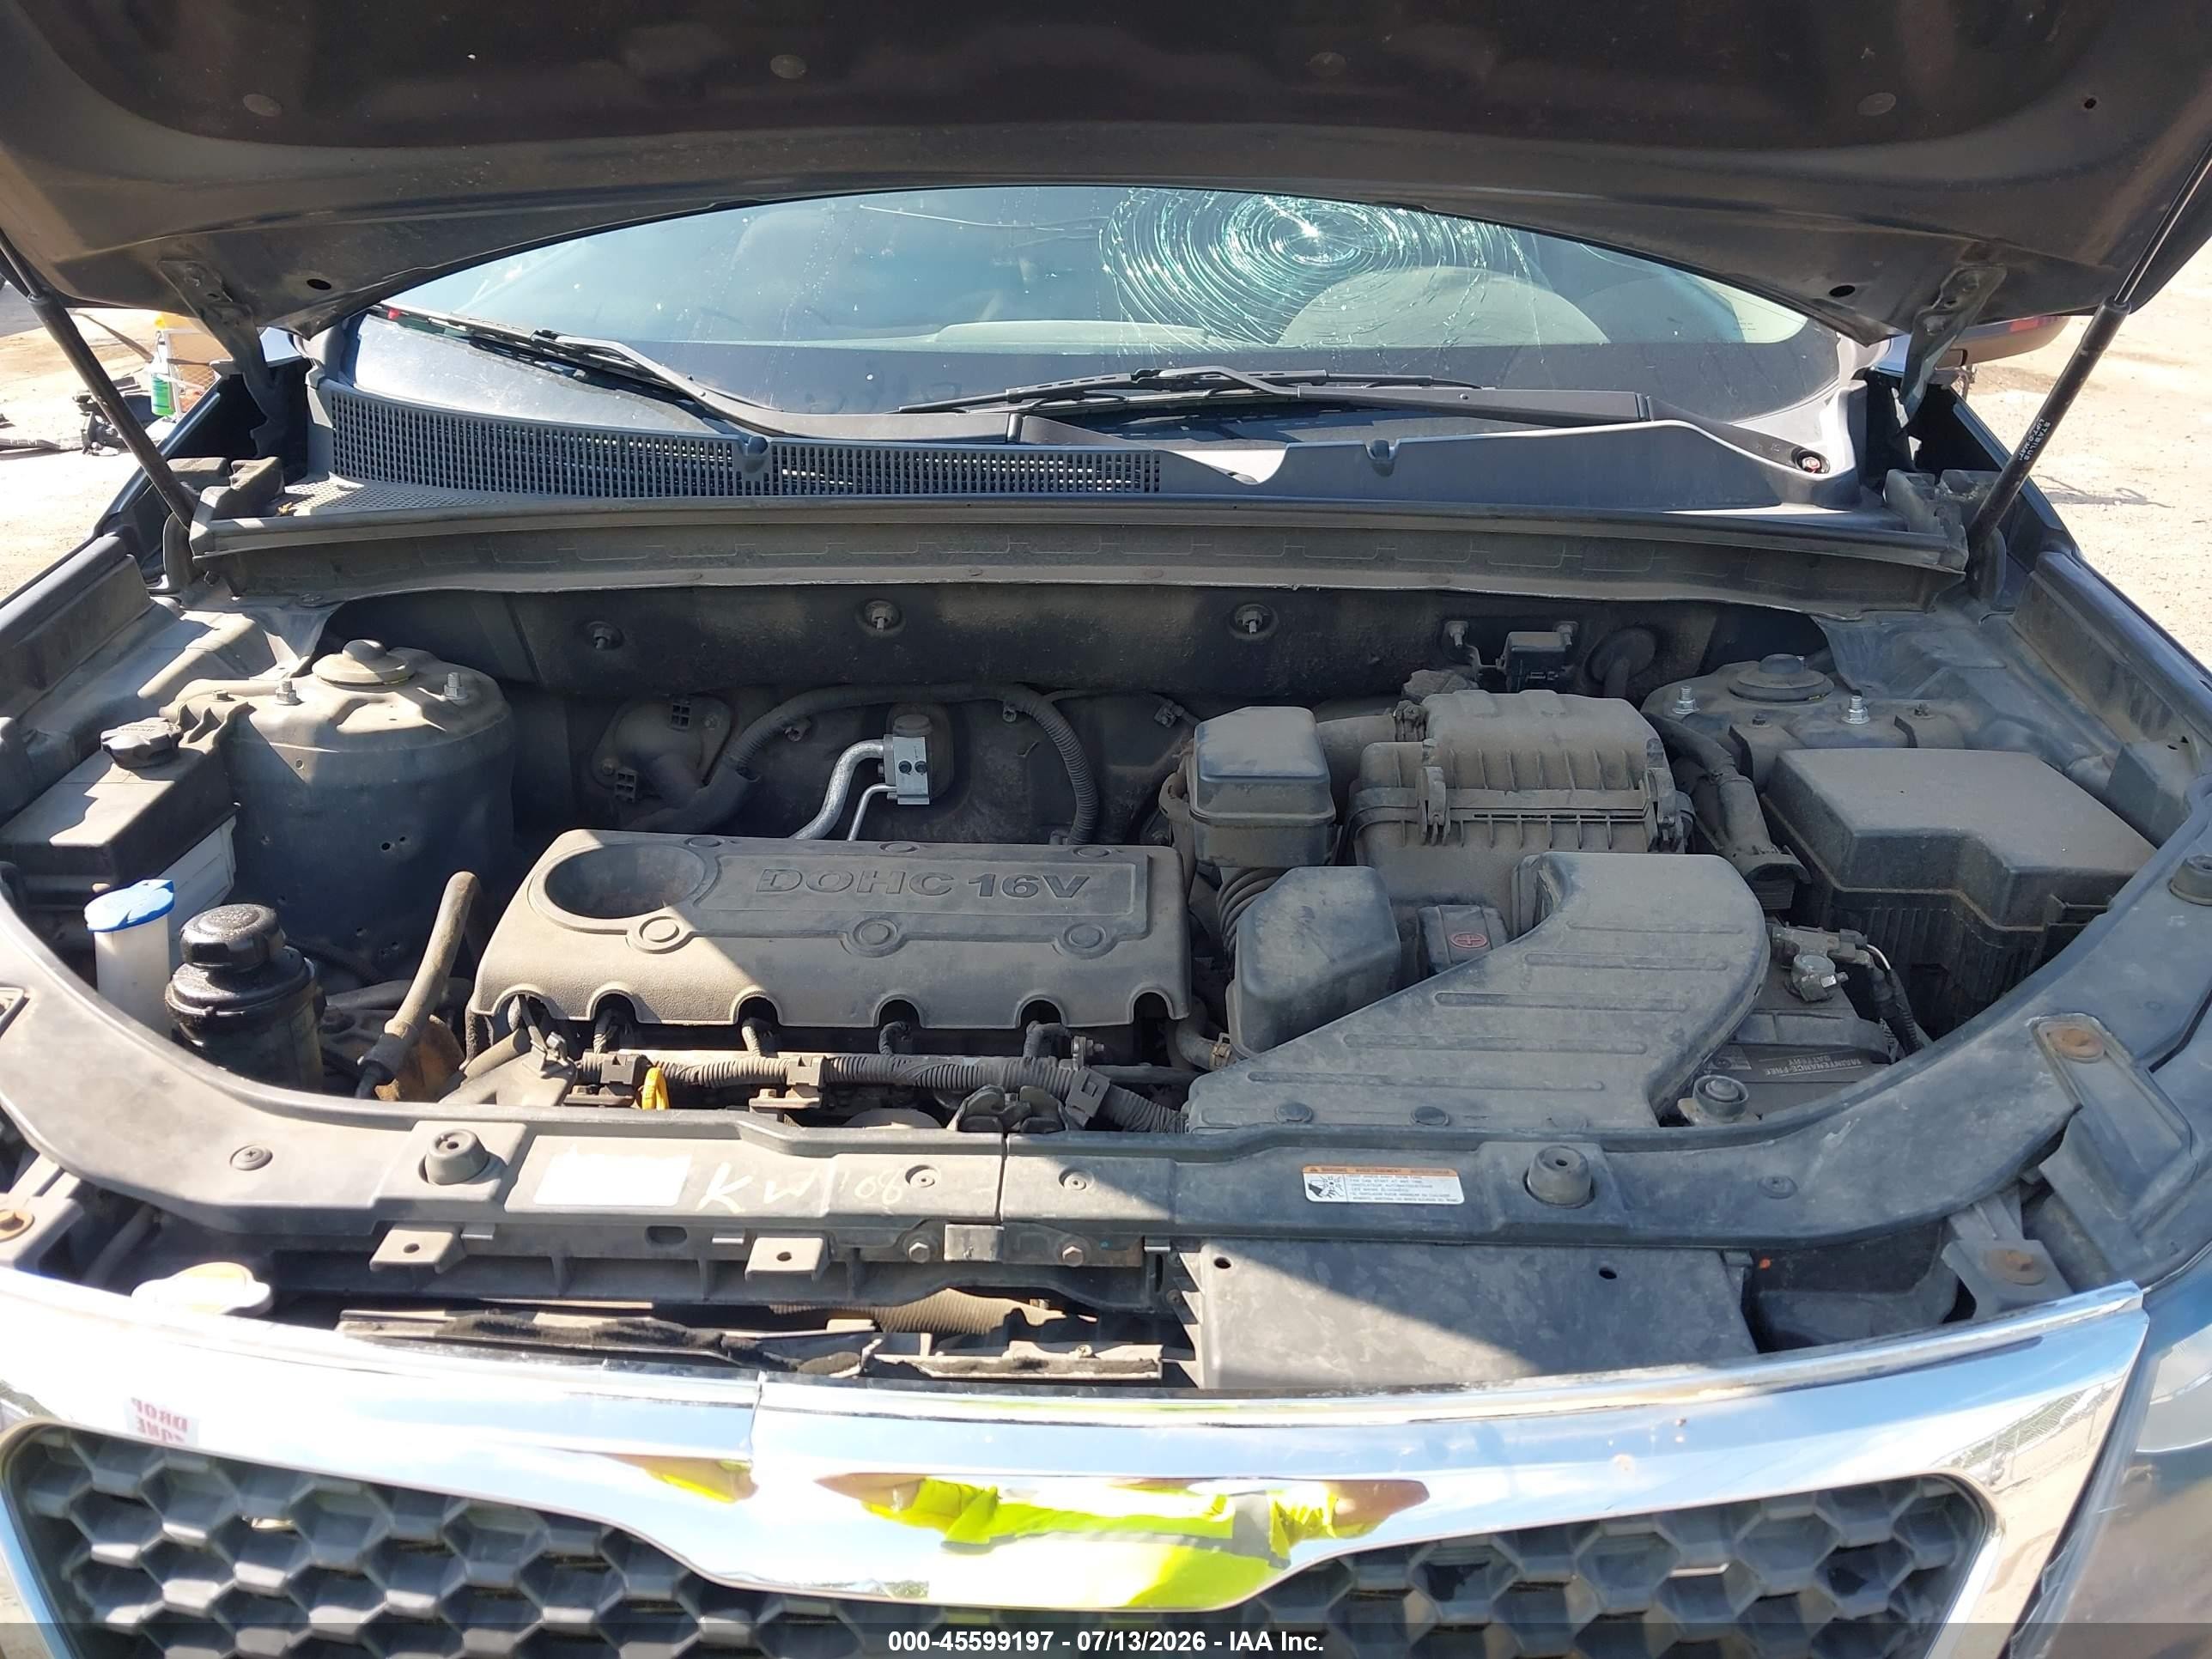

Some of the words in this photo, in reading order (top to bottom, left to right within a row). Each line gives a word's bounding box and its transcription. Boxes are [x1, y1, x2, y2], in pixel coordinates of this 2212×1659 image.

[2023, 421, 2051, 461] STABILUS
[756, 868, 953, 896] DOHC
[968, 872, 1091, 899] 16V
